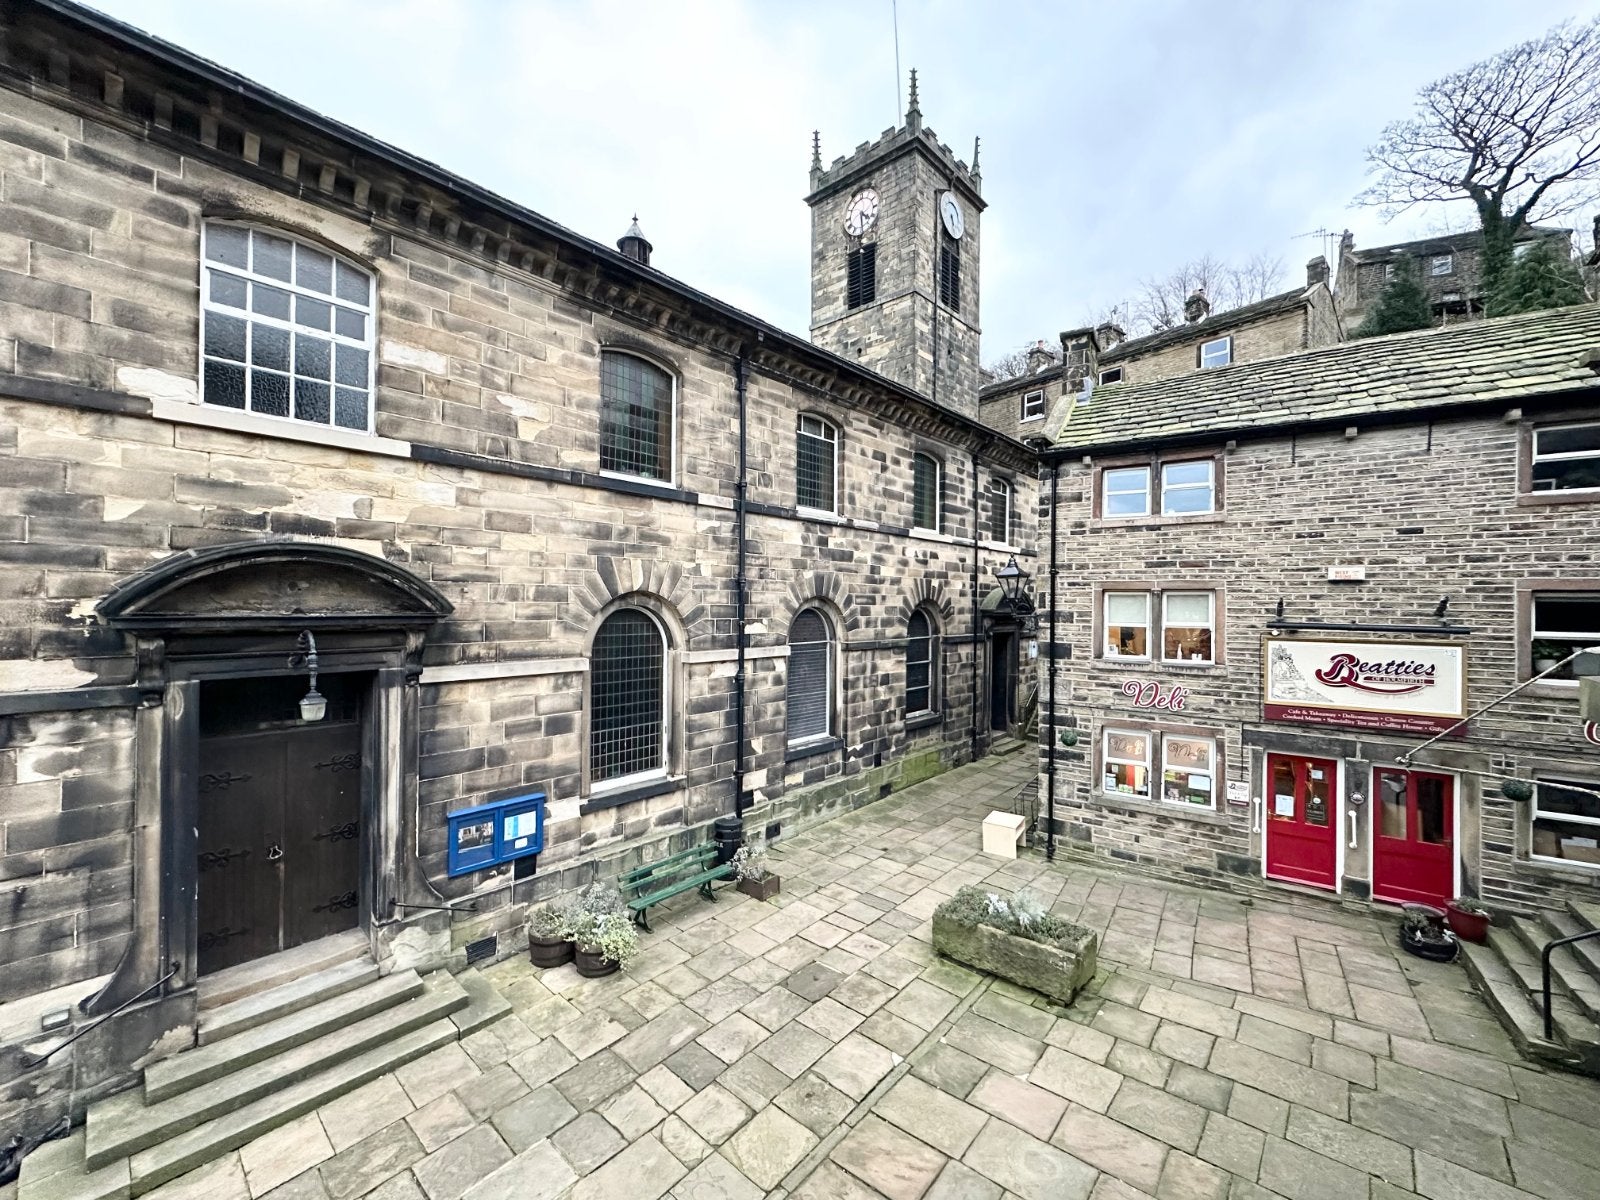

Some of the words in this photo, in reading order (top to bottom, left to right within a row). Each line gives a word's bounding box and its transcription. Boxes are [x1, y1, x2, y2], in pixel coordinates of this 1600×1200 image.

[1315, 653, 1436, 690] Beatties
[1122, 679, 1190, 711] Deli
[1309, 710, 1336, 718] Takeaway
[1380, 721, 1401, 729] Coffee
